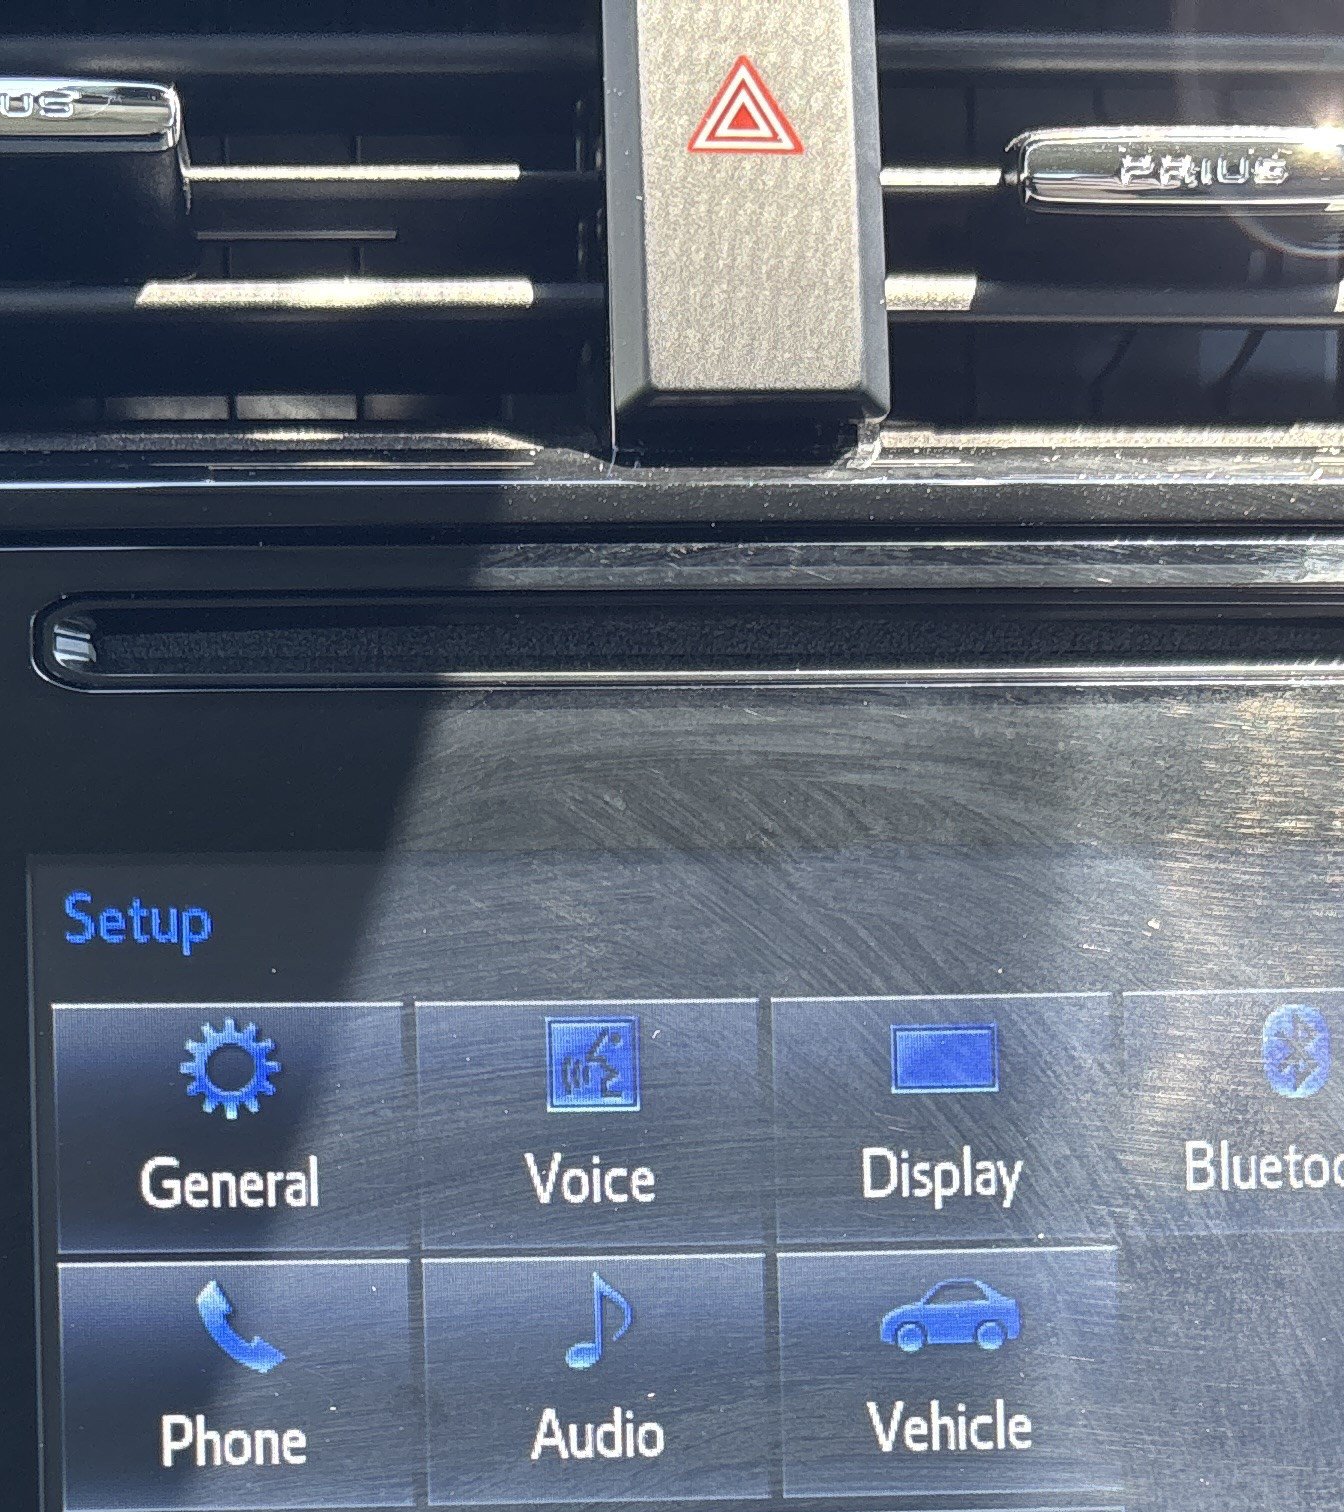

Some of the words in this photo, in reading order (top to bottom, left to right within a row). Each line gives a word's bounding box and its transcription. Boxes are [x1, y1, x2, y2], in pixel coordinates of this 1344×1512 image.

[64, 890, 215, 956] Setup
[139, 1154, 320, 1209] General
[523, 1150, 657, 1204] Voice
[861, 1145, 1024, 1211] Display
[160, 1414, 308, 1467] Phone
[530, 1407, 666, 1461] Audio
[866, 1399, 1033, 1452] Vehicle
